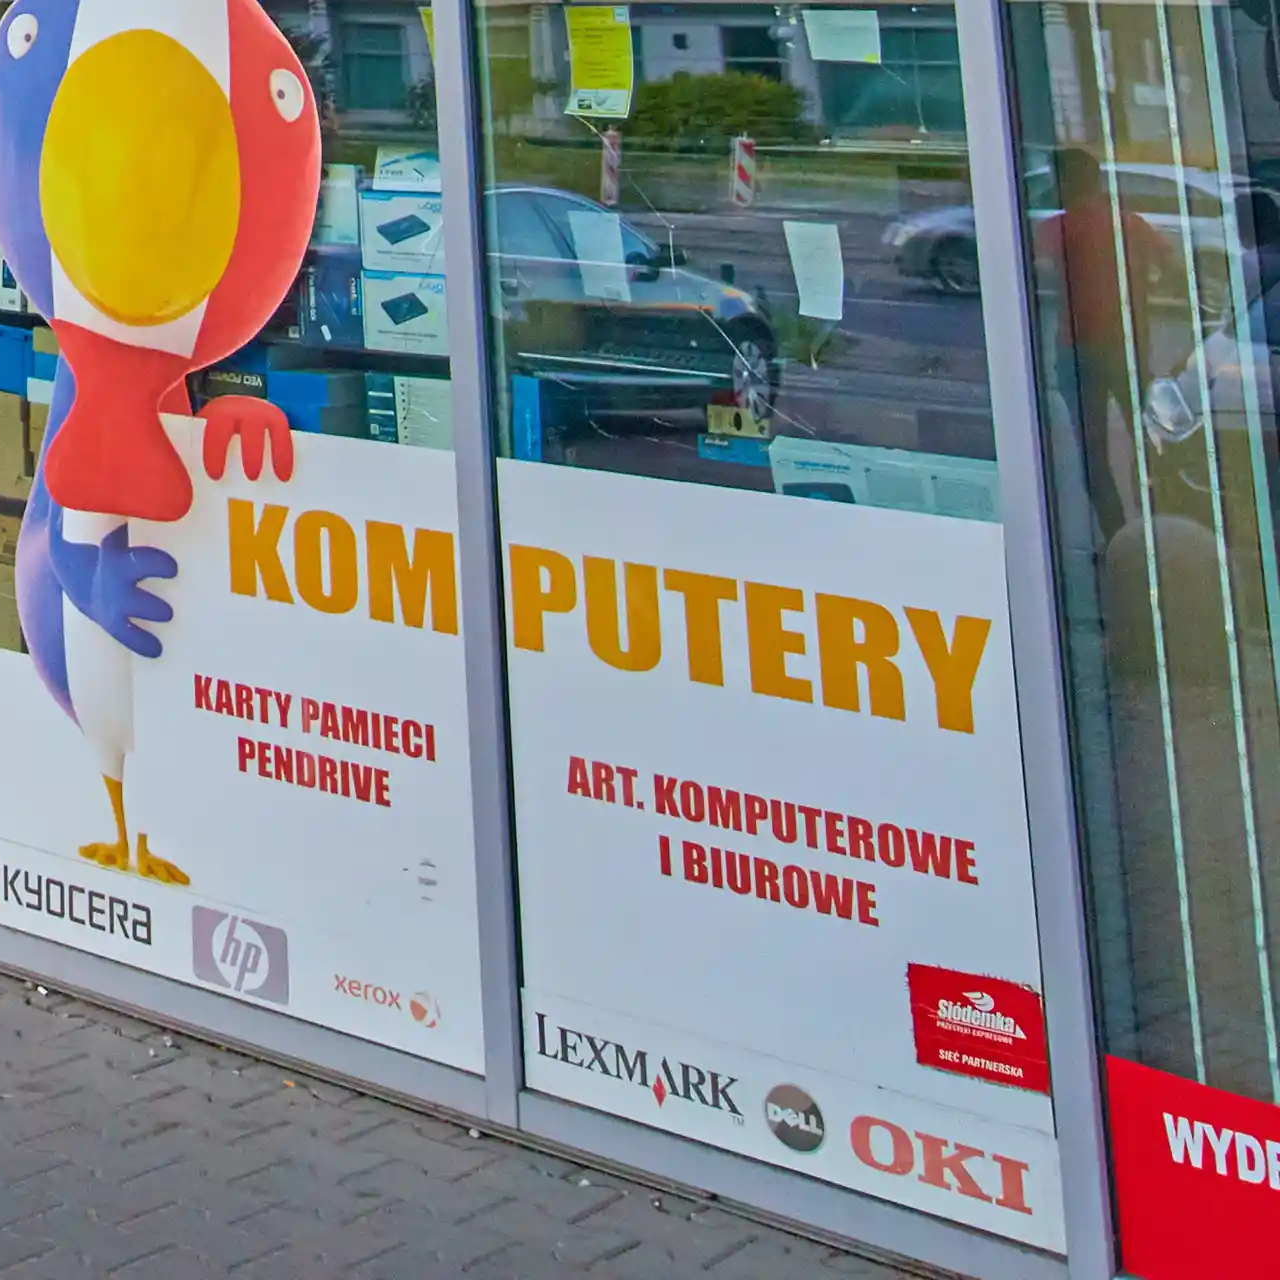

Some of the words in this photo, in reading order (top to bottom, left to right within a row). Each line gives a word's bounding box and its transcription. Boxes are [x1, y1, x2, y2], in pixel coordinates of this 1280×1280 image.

[194, 673, 292, 727] KARTY
[301, 696, 436, 762] PAMIECI
[238, 736, 391, 807] PENDRIVE
[566, 755, 645, 811] ART.
[653, 774, 980, 886] KOMPUTEROWE
[659, 835, 672, 877] I
[683, 842, 880, 927] BIUROWE
[219, 918, 263, 990] hp
[333, 972, 402, 1010] xerox
[535, 1011, 742, 1116] LEXMARK
[938, 1048, 960, 1063] SIEĆ
[961, 1054, 1024, 1079] PARTNERSKA
[766, 1101, 825, 1138] DELL
[850, 1115, 1034, 1216] OKI
